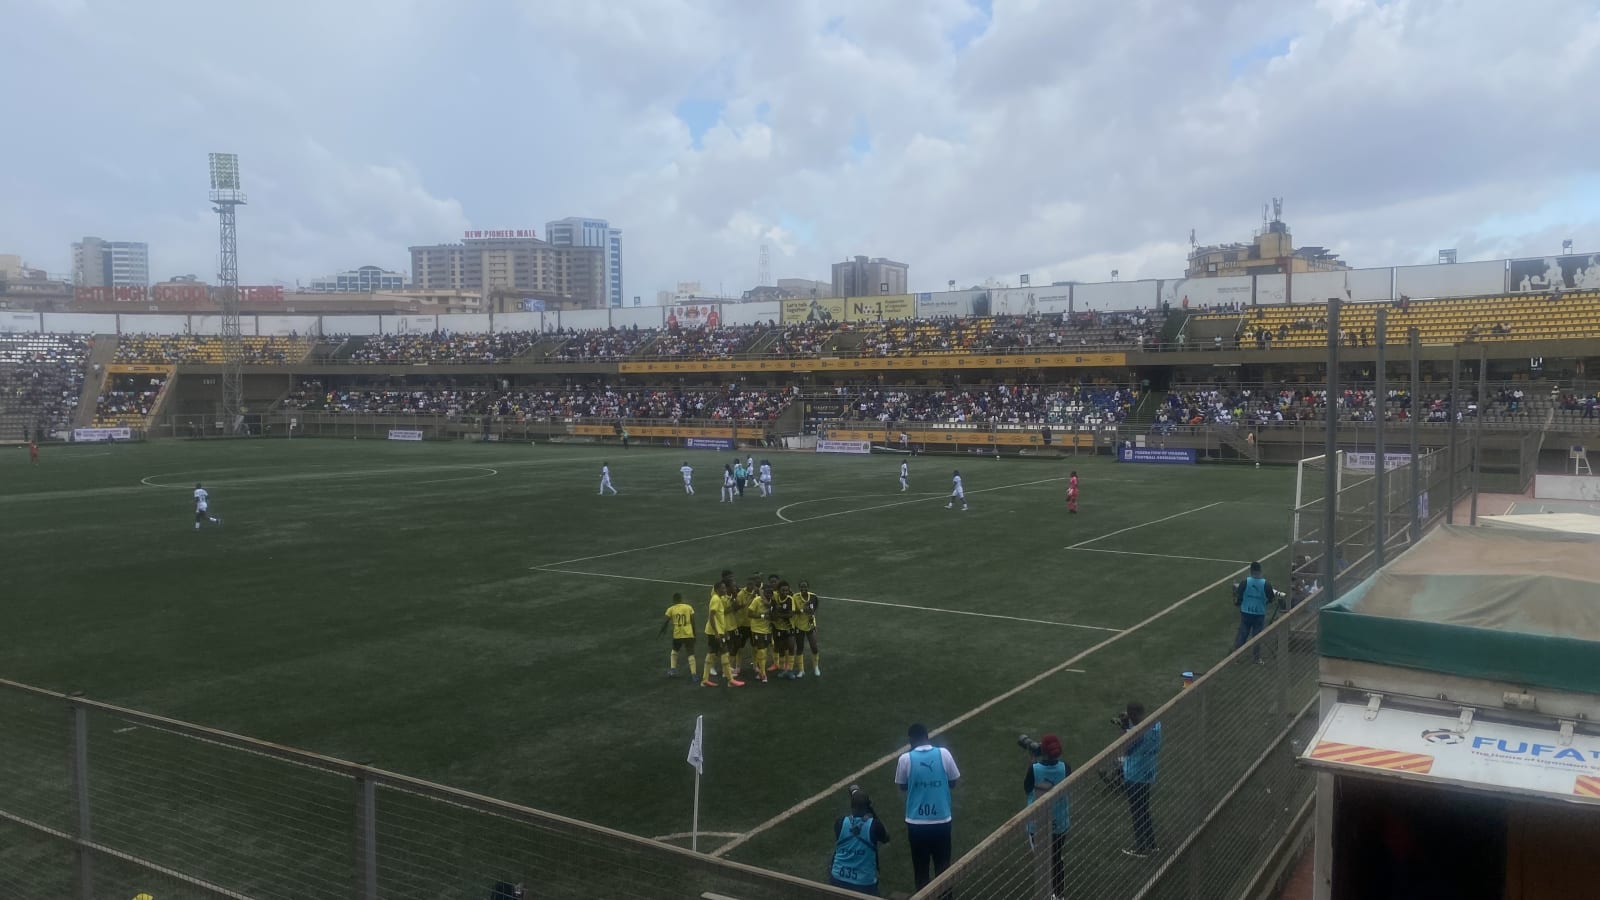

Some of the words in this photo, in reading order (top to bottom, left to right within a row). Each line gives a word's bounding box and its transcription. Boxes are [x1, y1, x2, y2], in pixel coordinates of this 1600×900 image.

[464, 230, 482, 238] NEW
[484, 230, 514, 238] PIONEER
[516, 229, 537, 237] MALL
[675, 613, 687, 627] 20
[1472, 736, 1586, 762] FUFA
[918, 803, 937, 816] 604
[840, 866, 858, 880] 635
